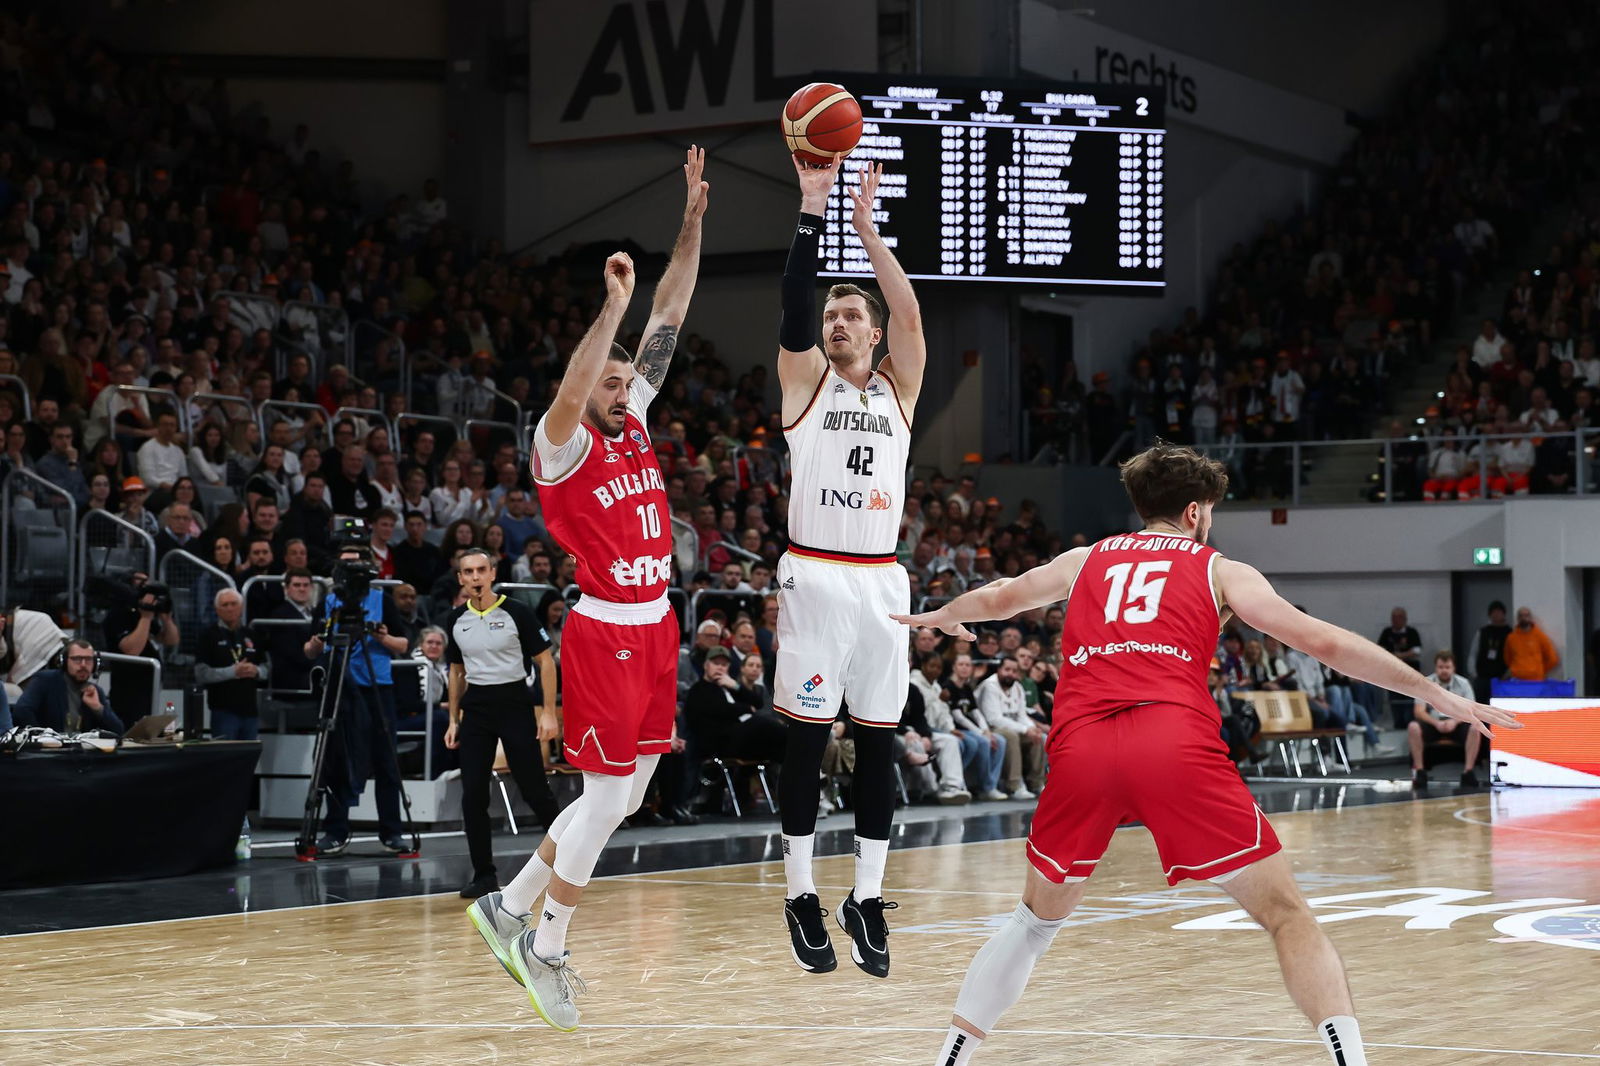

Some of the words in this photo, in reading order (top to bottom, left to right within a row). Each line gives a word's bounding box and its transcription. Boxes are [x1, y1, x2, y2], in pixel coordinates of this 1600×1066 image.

[560, 0, 788, 122] AWL
[1095, 46, 1197, 113] rechts
[1046, 93, 1096, 105] BULGARIA
[1136, 97, 1148, 115] 2
[846, 446, 874, 477] 42
[820, 488, 863, 509] ING
[636, 502, 661, 540] 10
[1104, 560, 1173, 625] 15
[797, 694, 826, 703] Domino's
